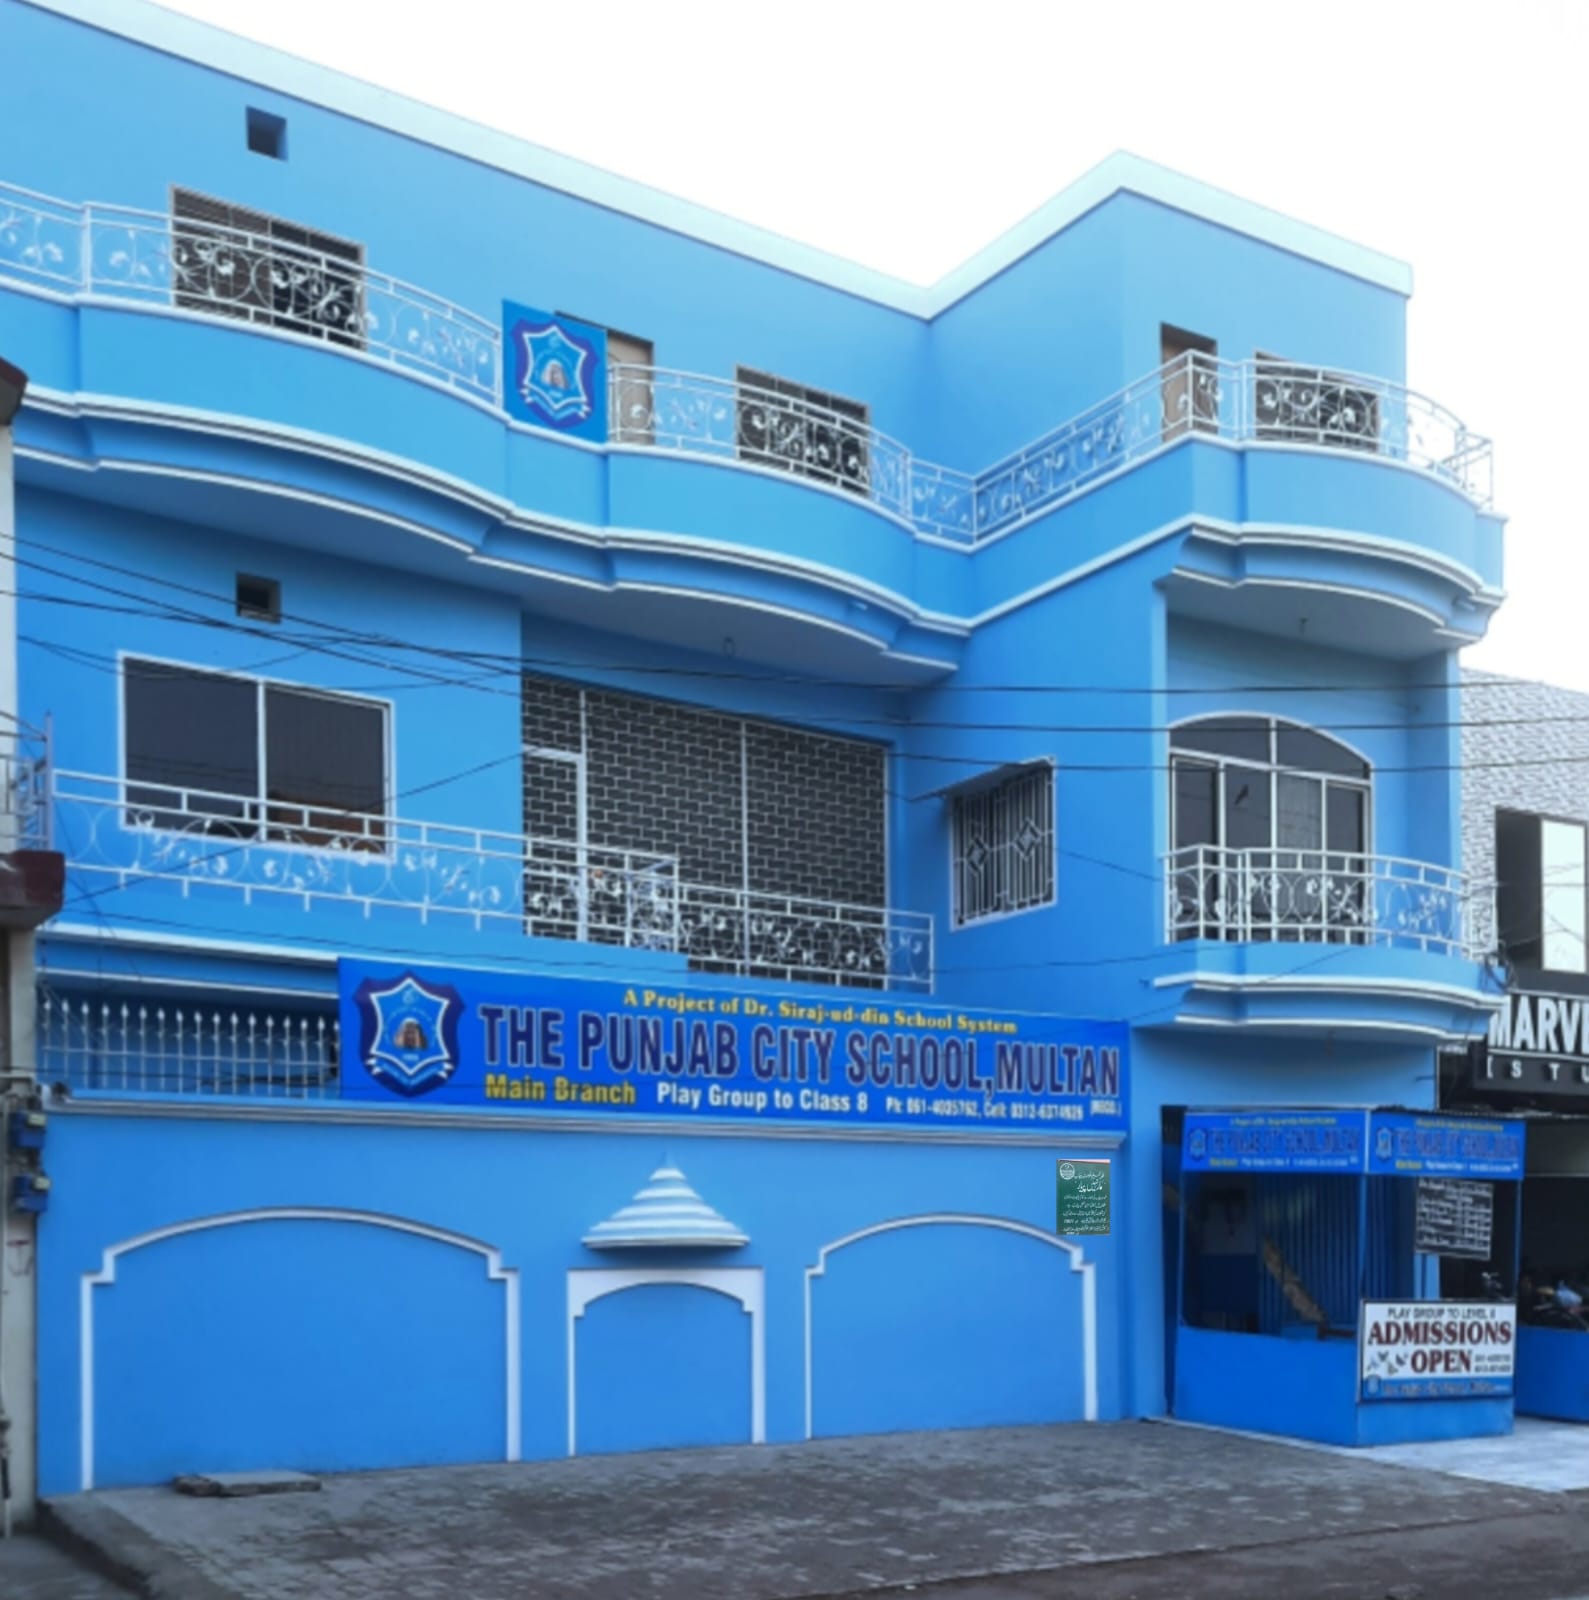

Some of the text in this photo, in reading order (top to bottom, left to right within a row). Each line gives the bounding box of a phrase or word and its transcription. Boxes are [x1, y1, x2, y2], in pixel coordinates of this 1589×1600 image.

[624, 988, 638, 1007] A
[643, 990, 715, 1013] Project
[720, 997, 739, 1013] of
[743, 998, 774, 1017] Dr.
[894, 1010, 951, 1029] School
[957, 1014, 1017, 1034] System
[478, 1003, 564, 1070] THE
[578, 1009, 738, 1079] PUNJAB
[753, 1023, 836, 1085] CITY
[485, 1073, 636, 1104] Main Branch
[657, 1081, 868, 1113] Play Group to Class 8
[1388, 1307, 1411, 1319] PLAY
[1368, 1321, 1511, 1345] ADMISSIONS
[1411, 1349, 1472, 1373] OPEN
